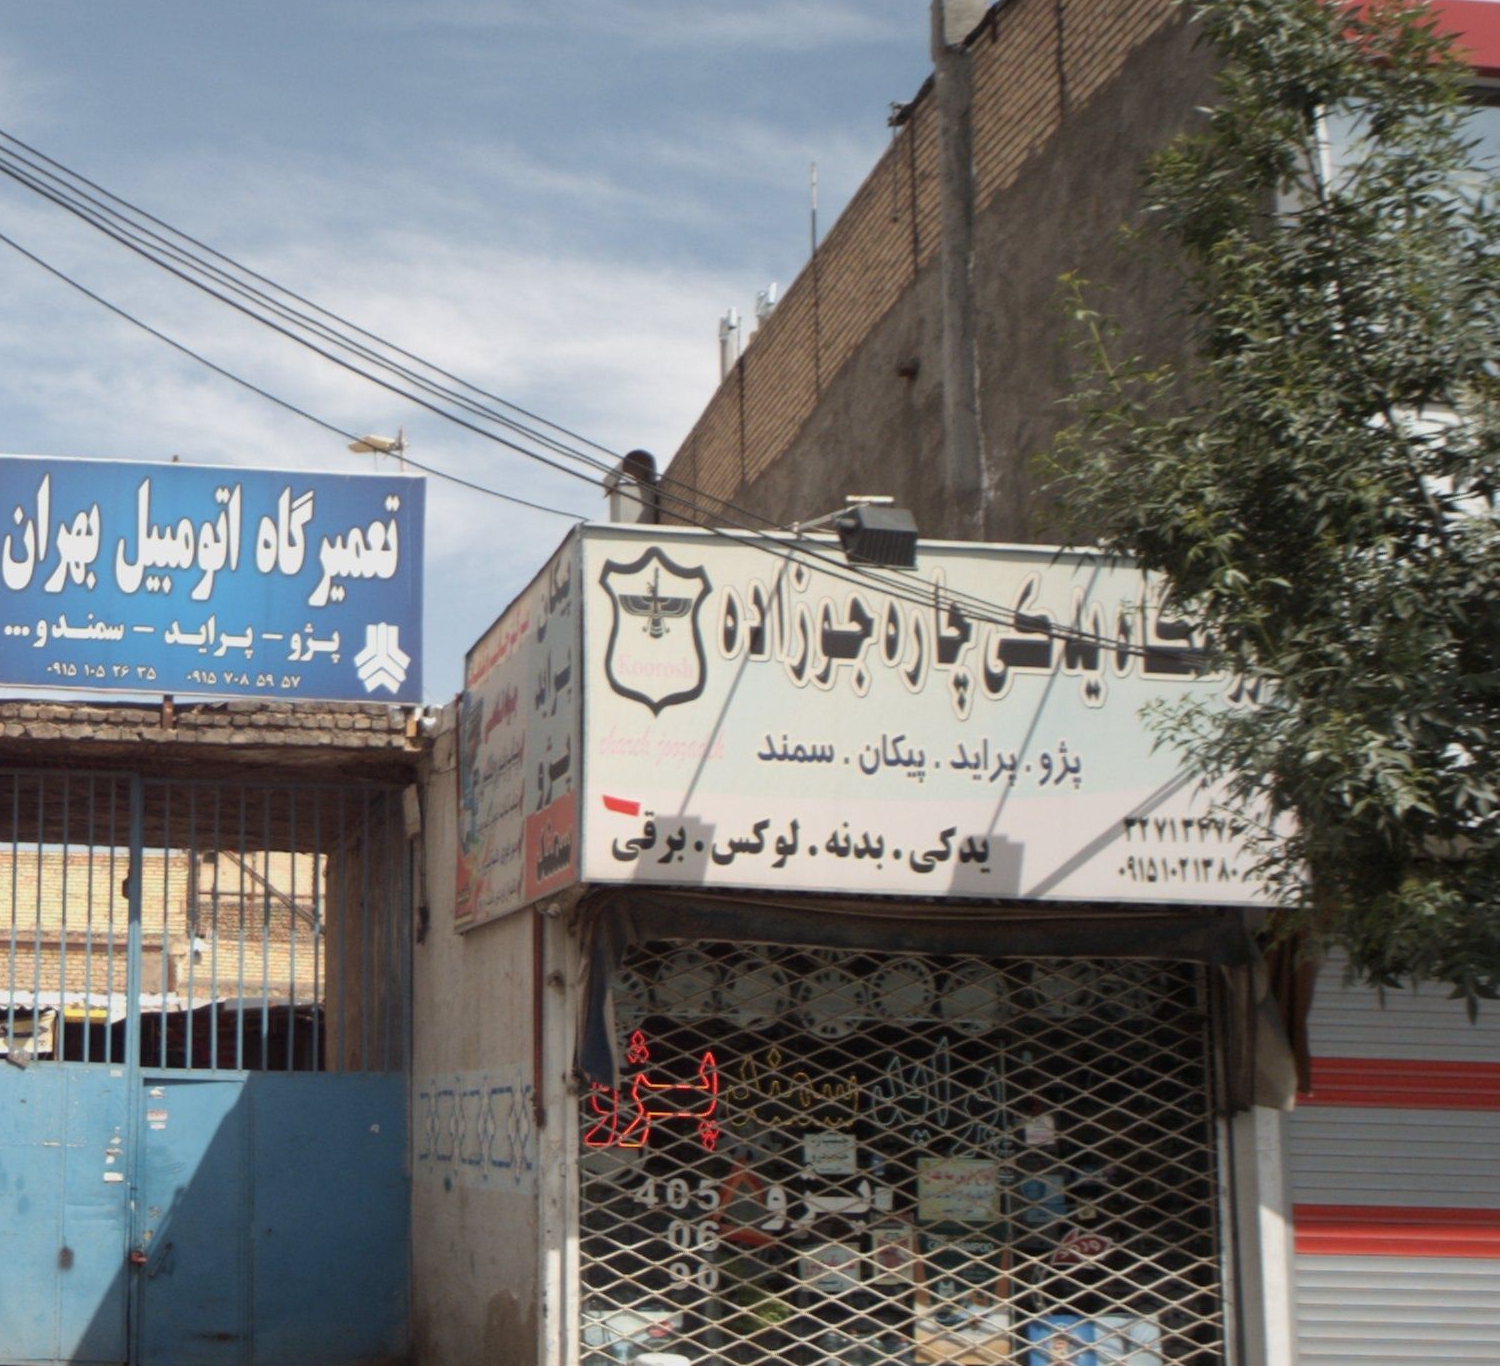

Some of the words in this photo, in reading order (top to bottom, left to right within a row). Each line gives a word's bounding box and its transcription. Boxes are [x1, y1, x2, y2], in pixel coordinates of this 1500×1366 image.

[2, 472, 100, 593] بهران
[115, 476, 242, 600] اتومبیل
[51, 613, 125, 641] سمند
[164, 614, 255, 658] پراید
[287, 621, 342, 663] پژو
[617, 653, 694, 679] Koorosh
[757, 734, 835, 764] سمند
[858, 733, 926, 784] پیکان
[949, 737, 1019, 787] پراید
[1038, 740, 1082, 789] پژو
[611, 809, 687, 864] برقی
[711, 817, 800, 869] لوکس
[825, 819, 885, 871] بدنه
[909, 825, 991, 874] یدکی
[633, 1177, 721, 1211] 405
